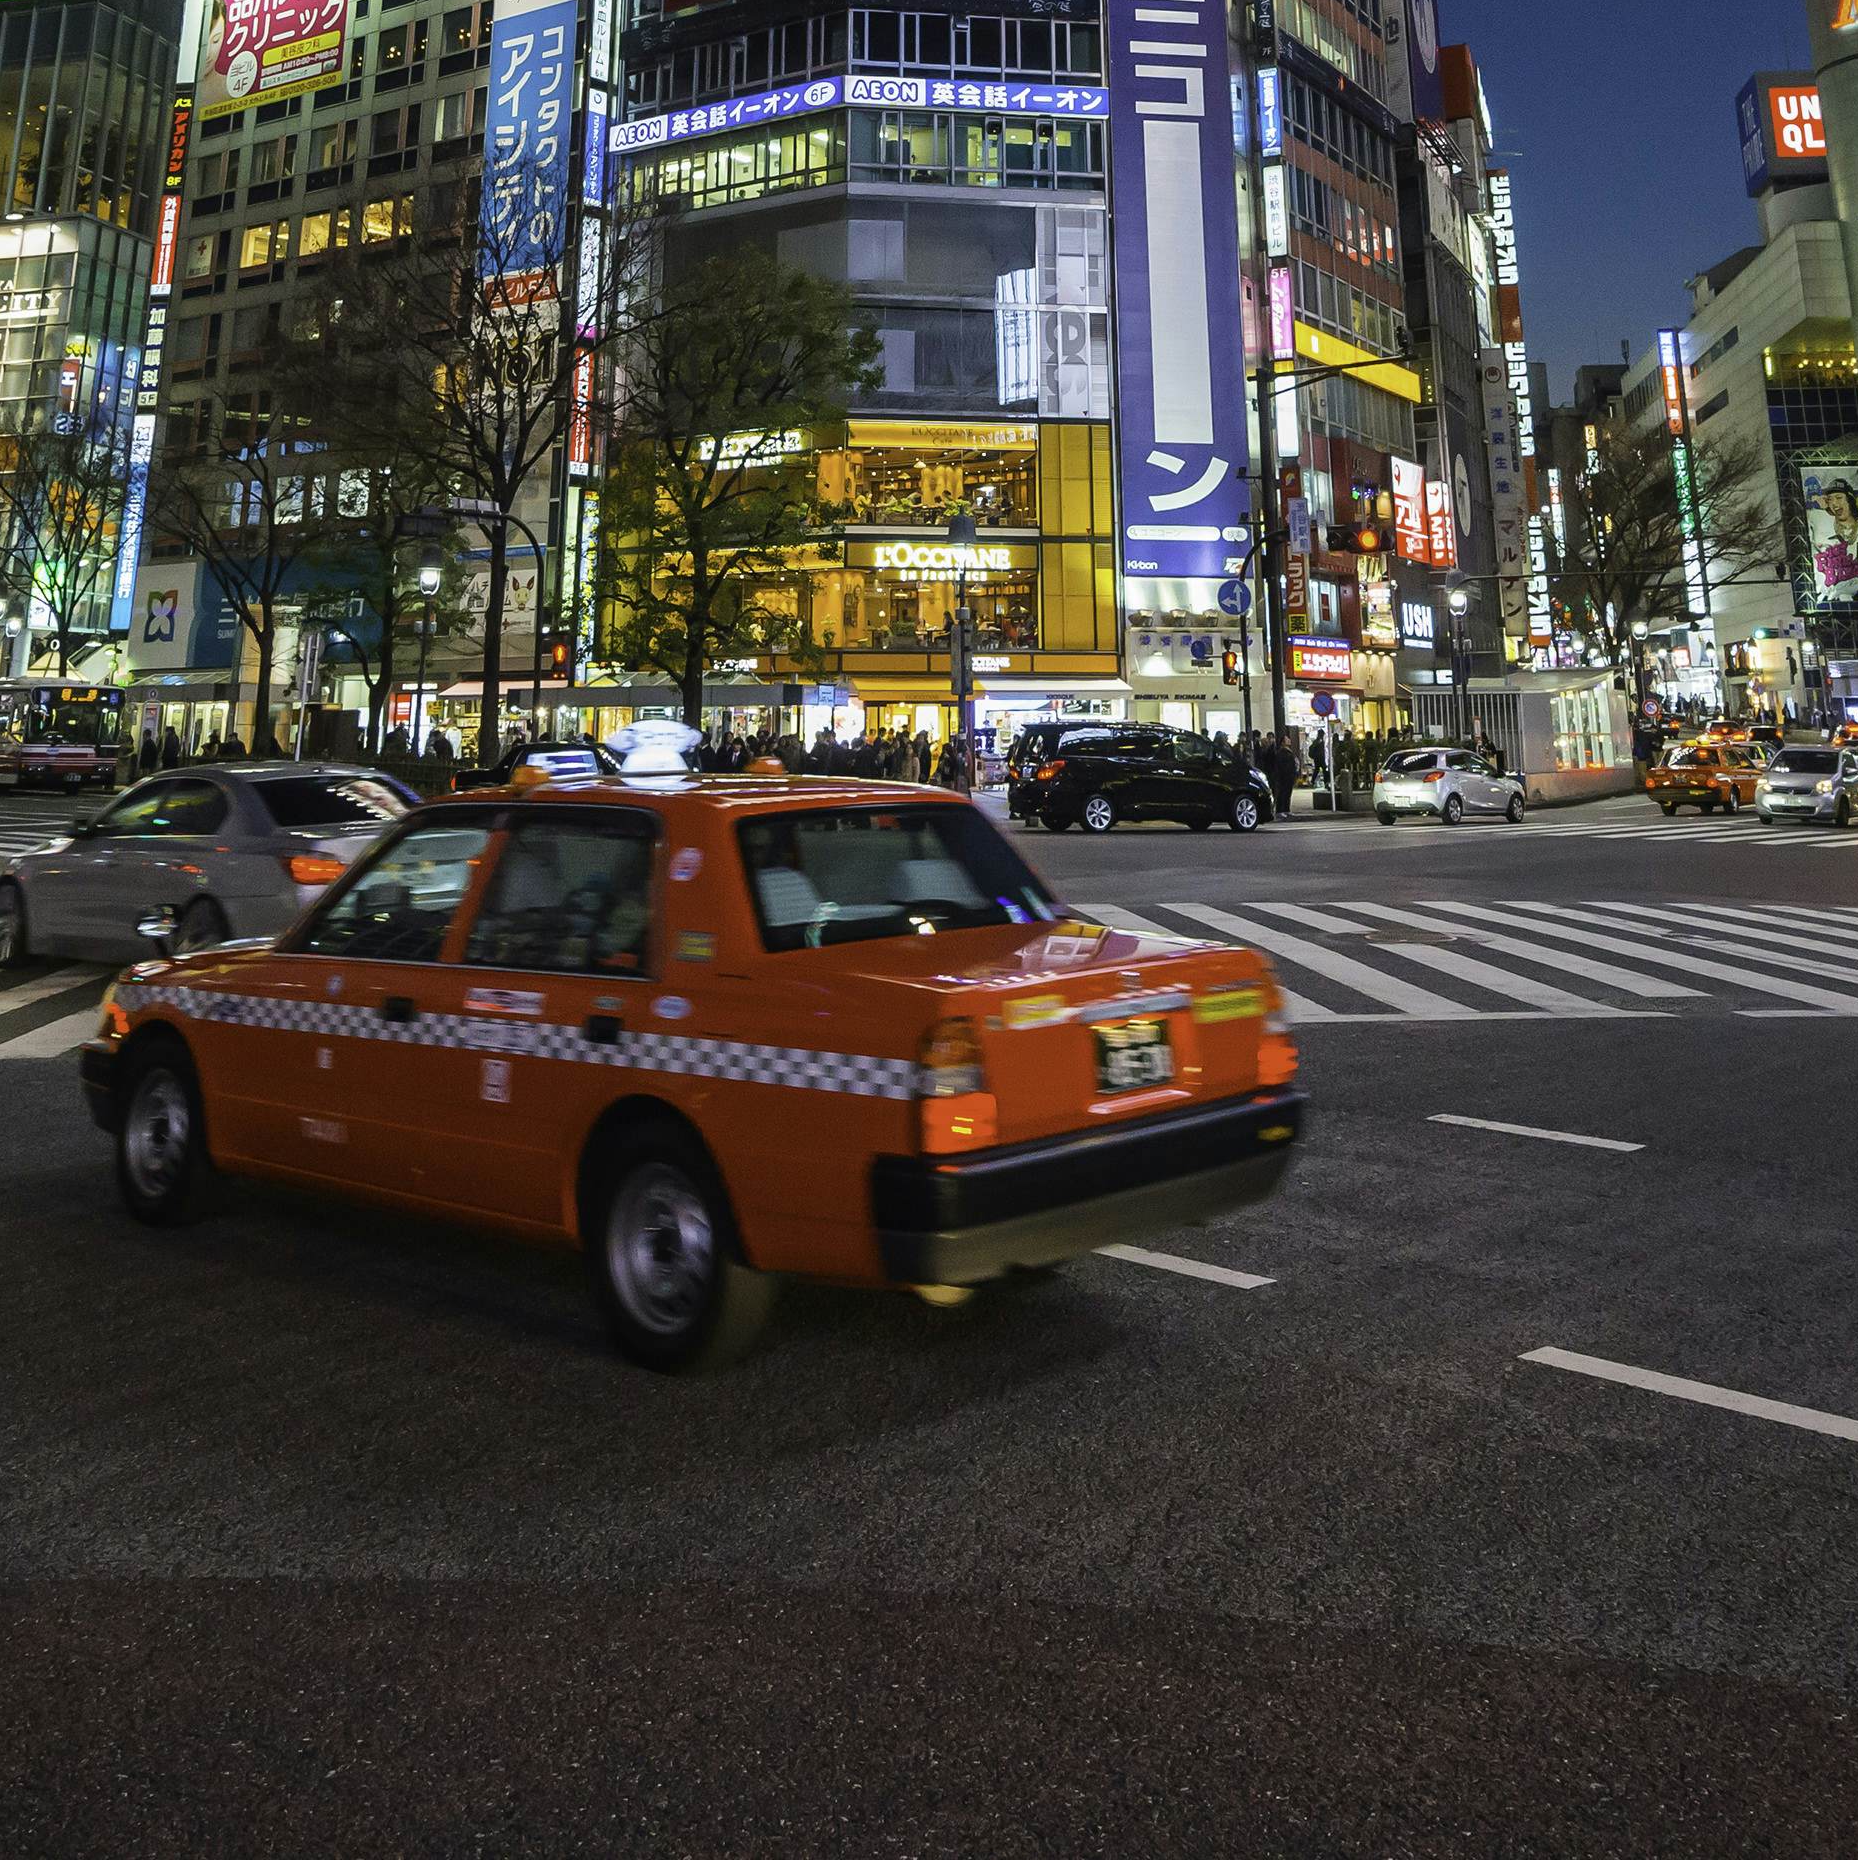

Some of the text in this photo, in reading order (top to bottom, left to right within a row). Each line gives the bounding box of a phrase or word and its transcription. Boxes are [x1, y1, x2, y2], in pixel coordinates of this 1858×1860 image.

[810, 87, 830, 104] 6F
[850, 79, 920, 103] AEON
[930, 81, 1103, 111] 英会話イーオン
[669, 91, 802, 138] 英会話イーオン
[1777, 95, 1823, 120] UN
[615, 123, 663, 148] AEON
[1781, 123, 1826, 154] QL
[165, 175, 183, 188] 8F
[1270, 267, 1289, 279] 5F
[140, 393, 155, 405] 5F
